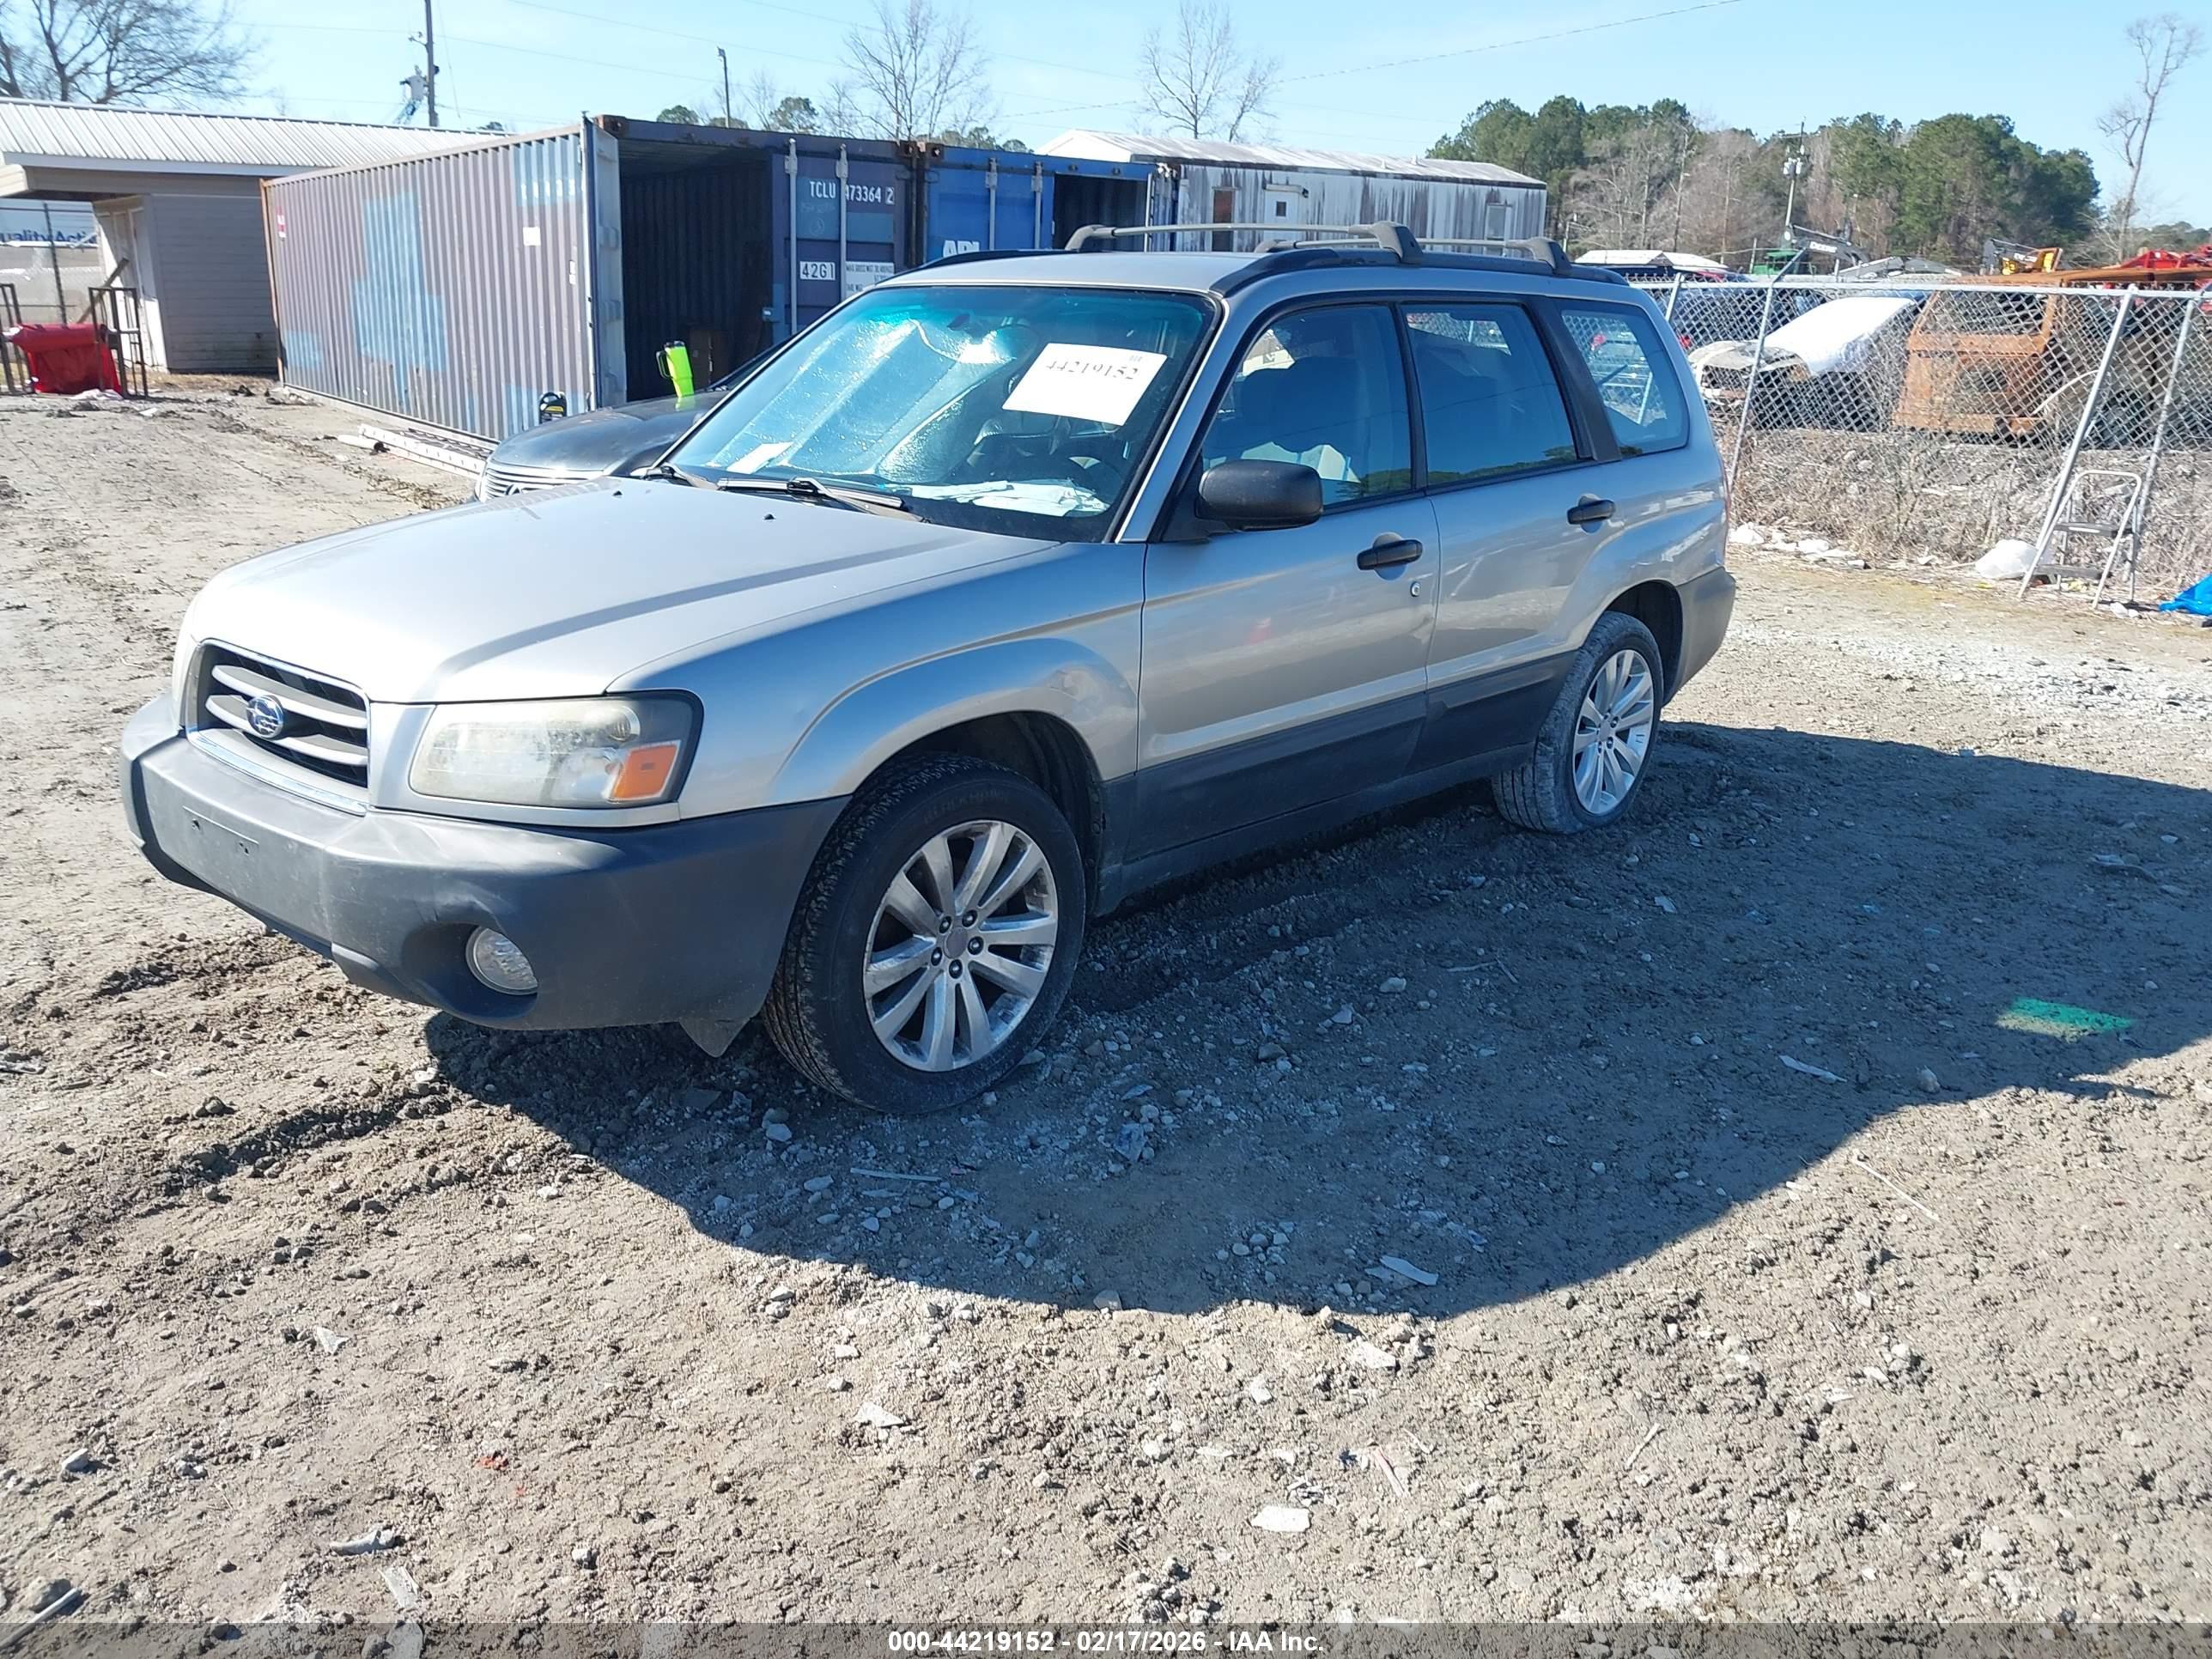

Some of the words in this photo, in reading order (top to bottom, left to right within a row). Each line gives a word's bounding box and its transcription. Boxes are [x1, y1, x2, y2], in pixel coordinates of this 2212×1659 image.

[810, 180, 836, 198] TCLU
[886, 186, 894, 204] 2
[802, 263, 835, 278] 42G1
[1045, 360, 1139, 380] 44219152
